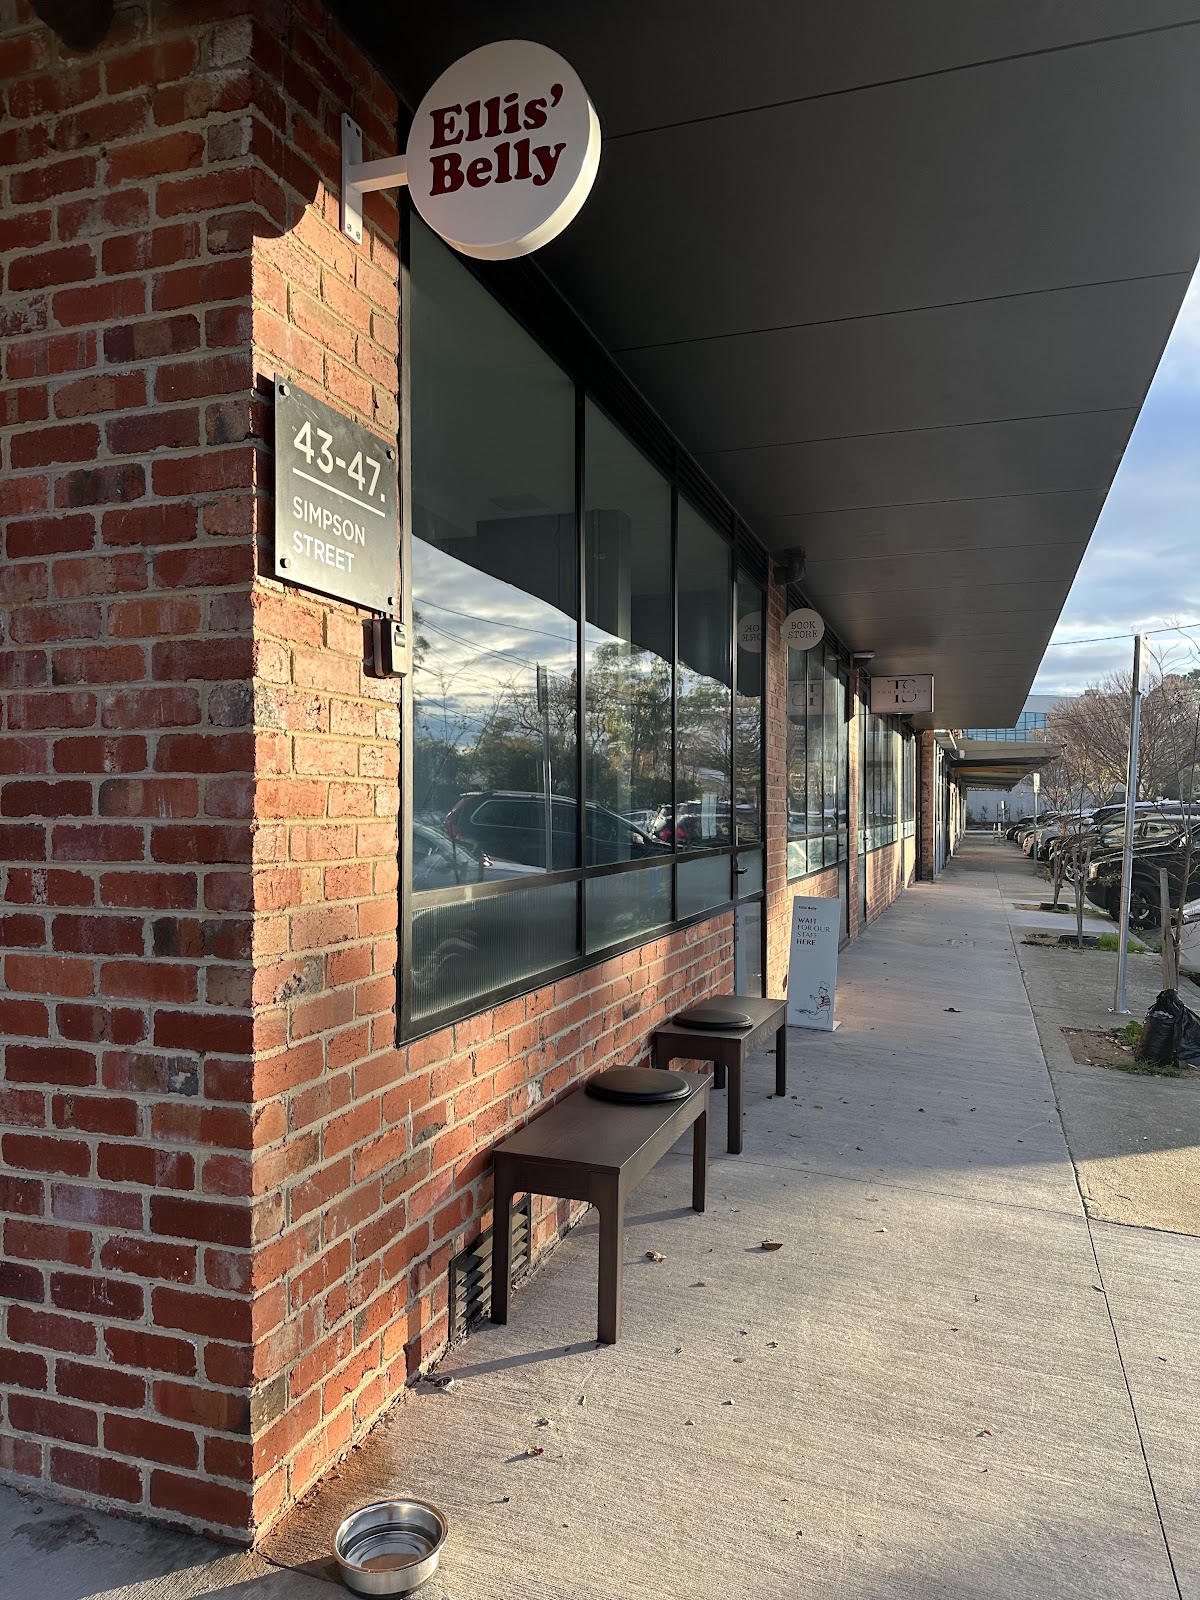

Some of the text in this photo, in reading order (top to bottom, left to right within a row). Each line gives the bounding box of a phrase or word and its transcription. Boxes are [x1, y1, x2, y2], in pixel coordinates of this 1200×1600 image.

[429, 137, 567, 197] Belly
[293, 420, 386, 503] 43-47.
[292, 495, 365, 547] SIMPSON
[292, 530, 355, 573] STREET
[787, 630, 818, 639] STORE
[791, 620, 816, 630] BOOK
[796, 938, 816, 946] HERE
[797, 931, 817, 939] STAFF
